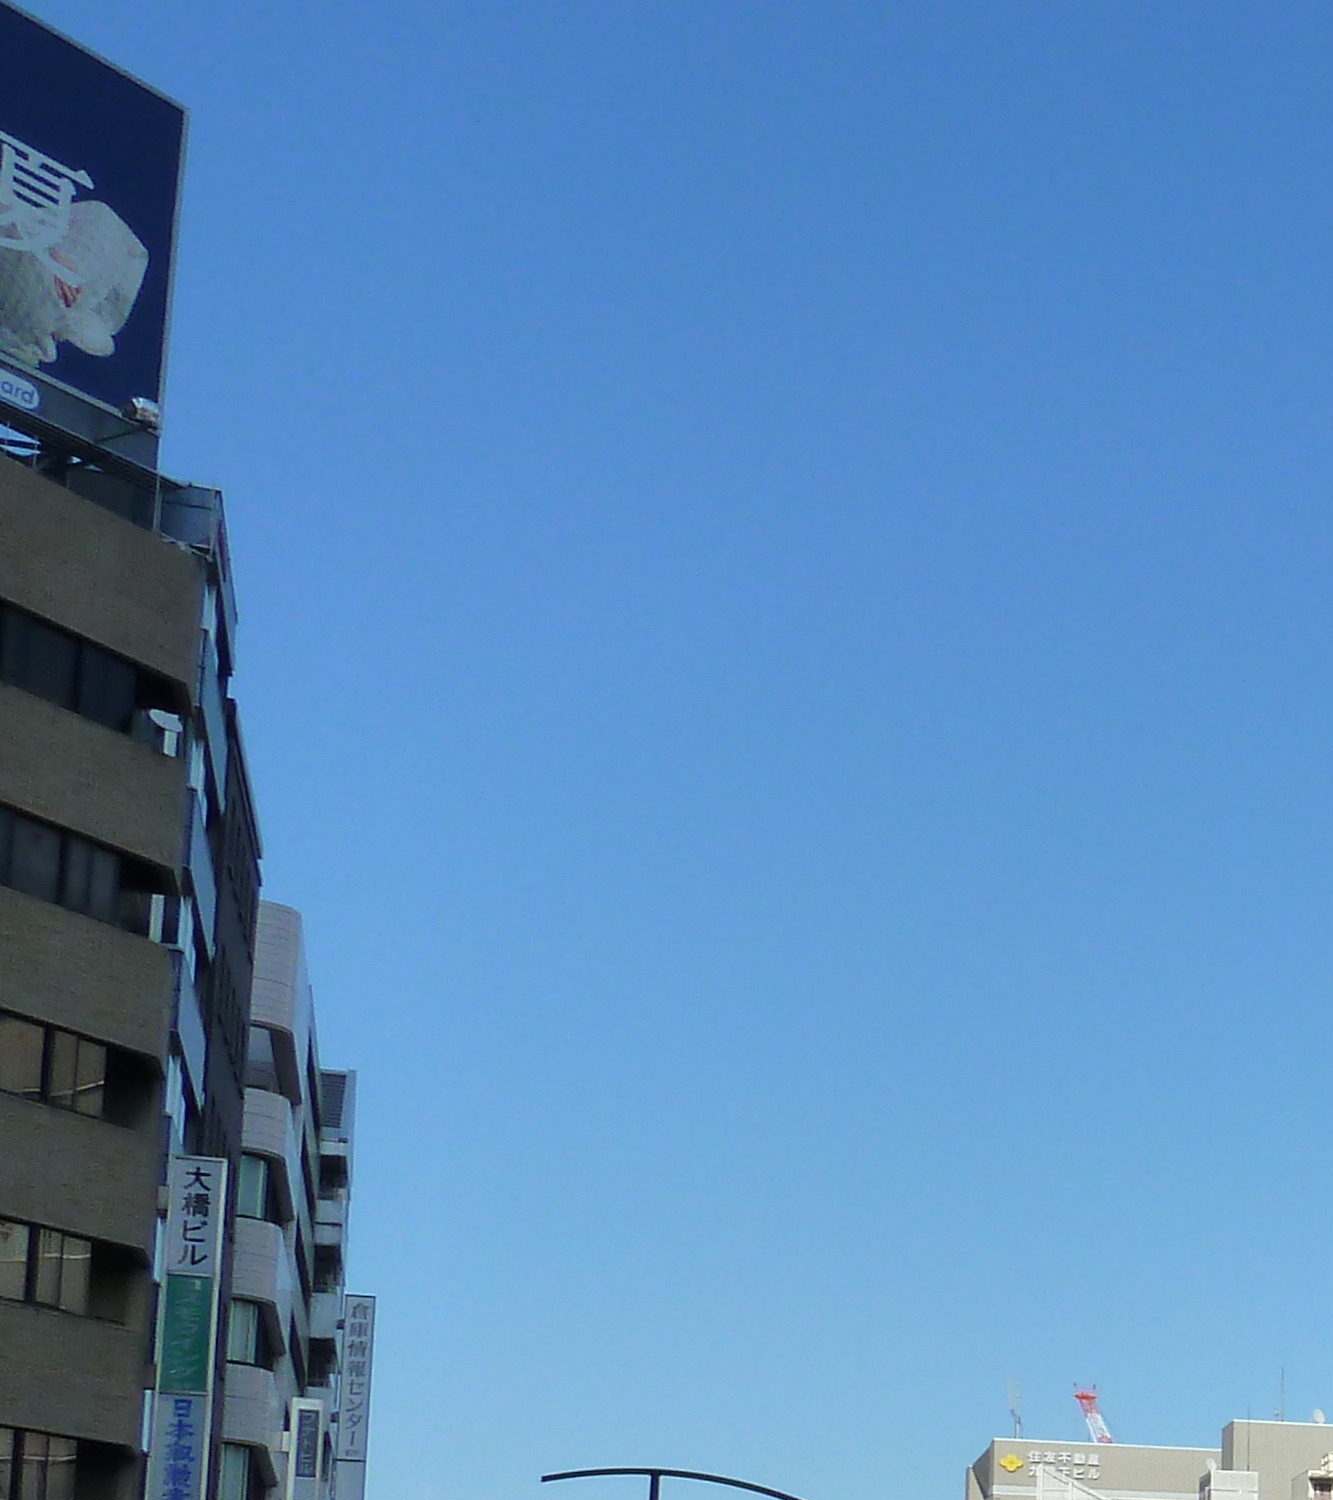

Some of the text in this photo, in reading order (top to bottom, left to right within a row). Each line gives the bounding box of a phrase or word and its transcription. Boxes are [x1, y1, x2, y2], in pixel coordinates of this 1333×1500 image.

[178, 1166, 213, 1265] 大橋ビル
[345, 1302, 370, 1447] 倉庫情報センター
[1028, 1451, 1100, 1466] 住友不動産
[1028, 1466, 1100, 1480] 九下ビル
